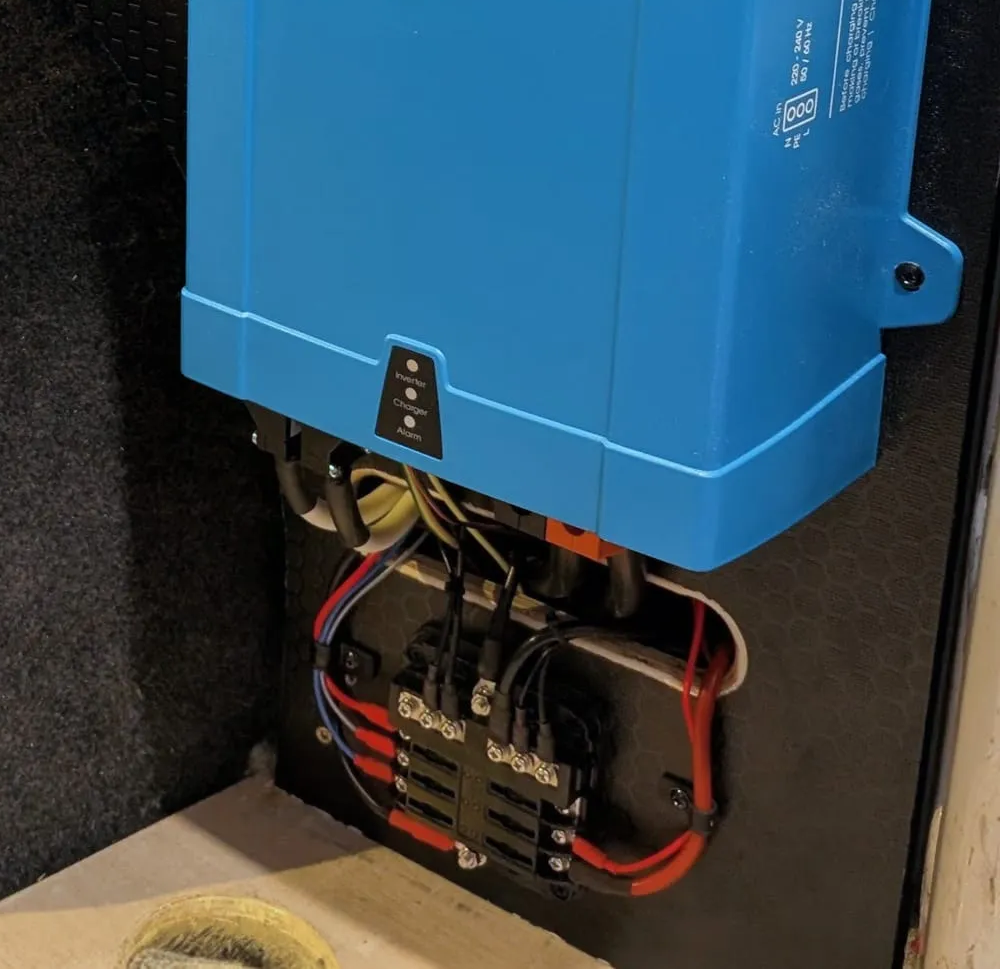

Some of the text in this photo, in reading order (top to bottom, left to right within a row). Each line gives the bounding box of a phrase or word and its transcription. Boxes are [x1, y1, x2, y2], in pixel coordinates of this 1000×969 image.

[796, 18, 804, 28] V
[805, 21, 813, 37] Hz
[859, 7, 871, 57] prevent
[794, 30, 803, 52] 240
[803, 39, 812, 54] 60
[839, 69, 850, 112] Before
[845, 3, 858, 62] charging
[790, 64, 799, 86] 220
[860, 41, 873, 99] charging
[846, 59, 859, 107] making
[772, 103, 782, 136] AC in
[793, 134, 801, 148] PE
[395, 372, 426, 387] Inverter
[393, 398, 428, 416] Charger
[397, 426, 422, 442] Alarm
